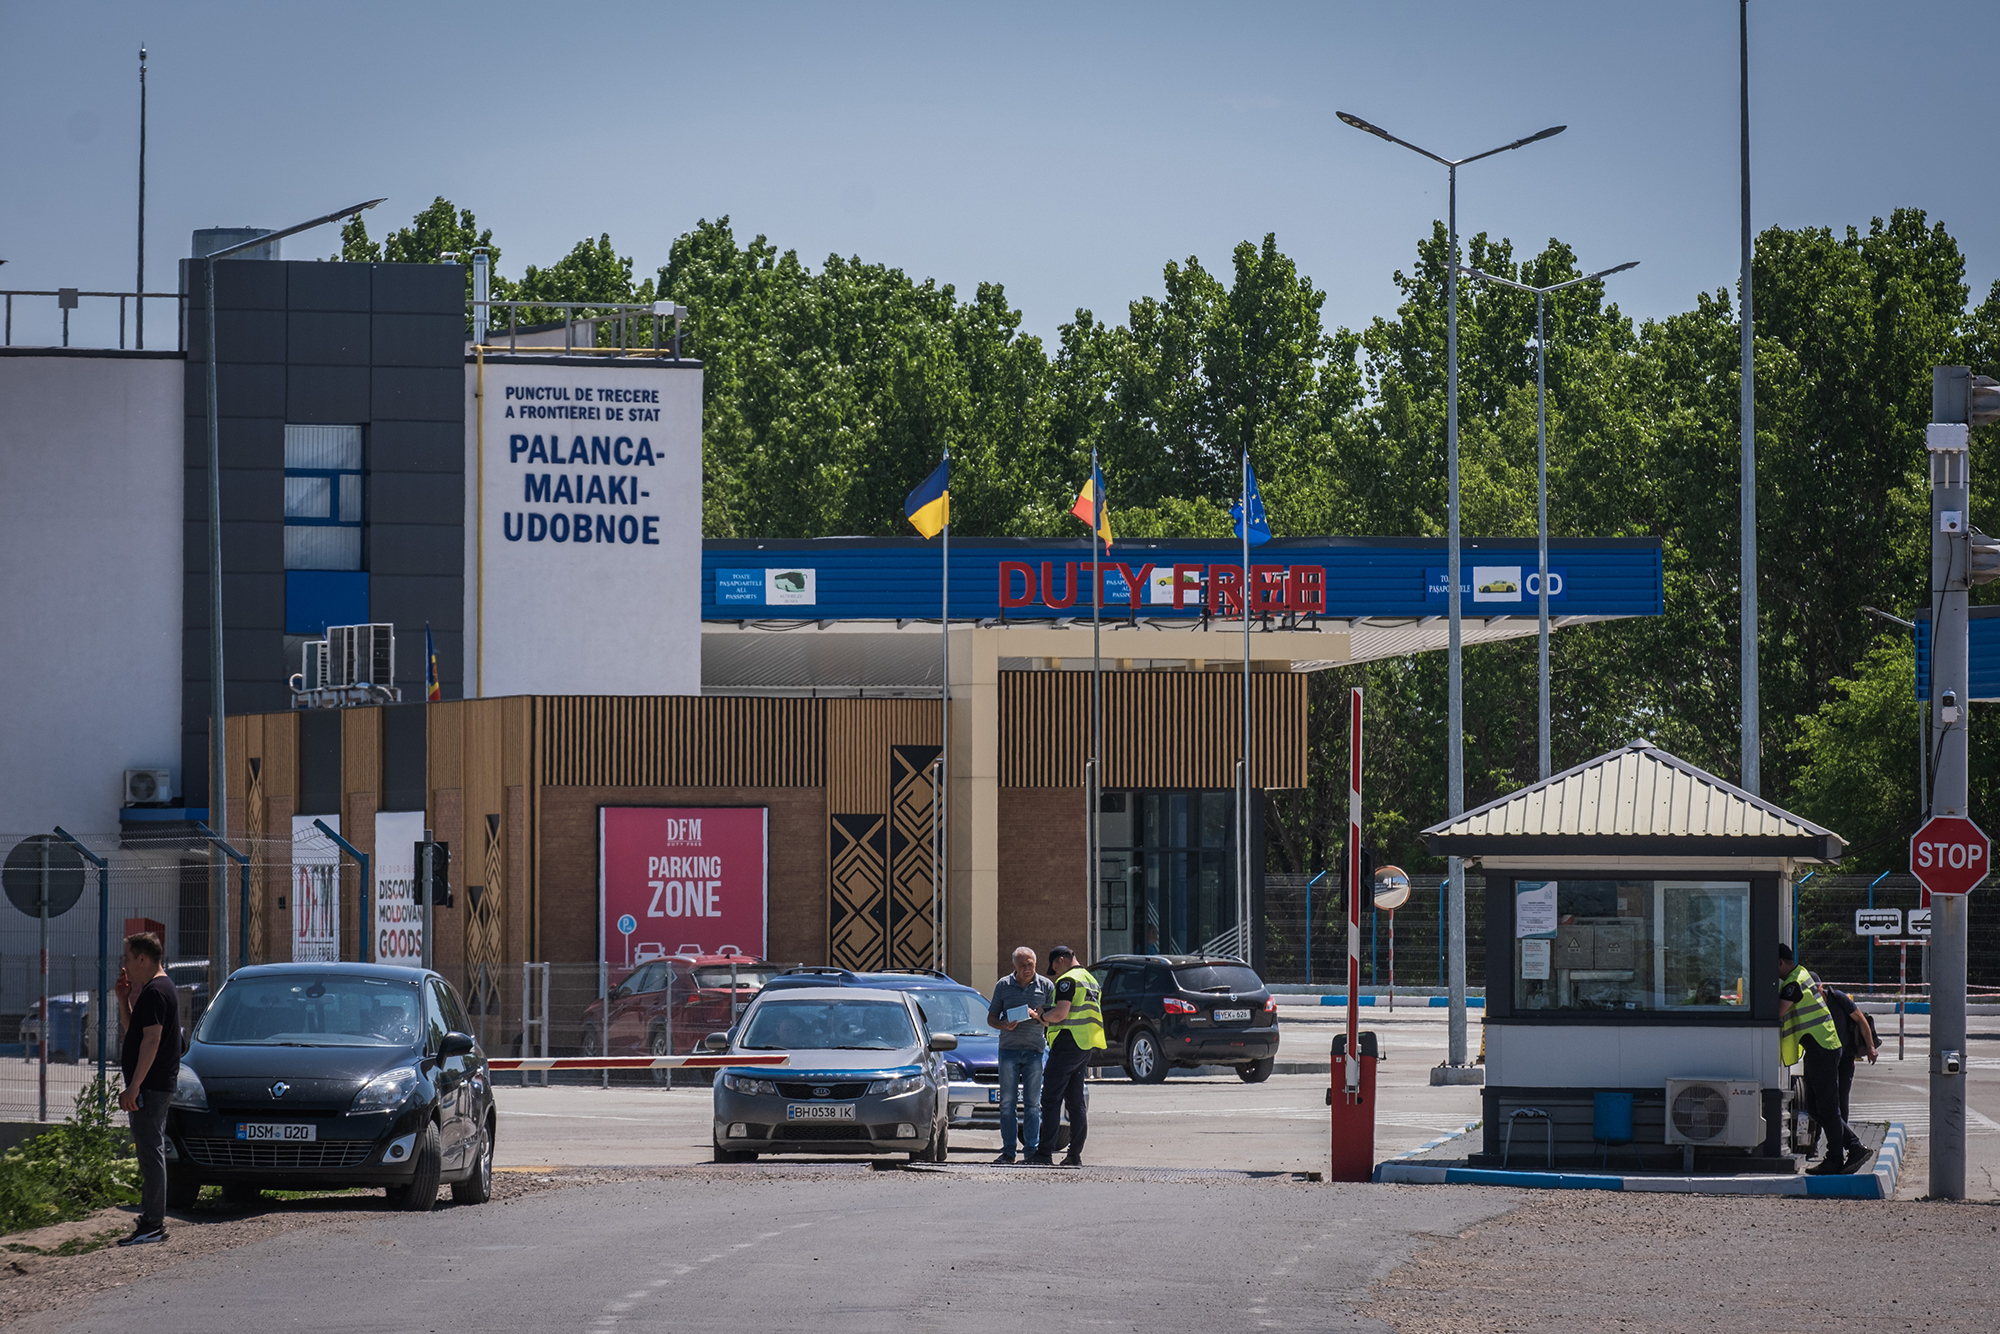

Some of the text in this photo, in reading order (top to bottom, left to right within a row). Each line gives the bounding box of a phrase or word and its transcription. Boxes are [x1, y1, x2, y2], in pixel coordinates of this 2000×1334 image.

[505, 386, 659, 403] PUNCTUL DE TRECERE
[505, 406, 660, 422] A FRONTIEREI DE STAT
[510, 434, 665, 467] PALANCA-
[525, 473, 650, 505] MAIAKI-
[504, 512, 660, 545] UDOBNOE
[999, 560, 1324, 612] DUTY FREE
[667, 818, 702, 841] DFM
[648, 856, 722, 878] PARKING
[1918, 842, 1983, 869] STOP
[379, 878, 415, 900] DISCOVE
[647, 880, 722, 918] ZONE
[379, 928, 422, 959] GOODS
[794, 1107, 852, 1118] BH 0538 IK
[248, 1125, 309, 1140] DSM 020
